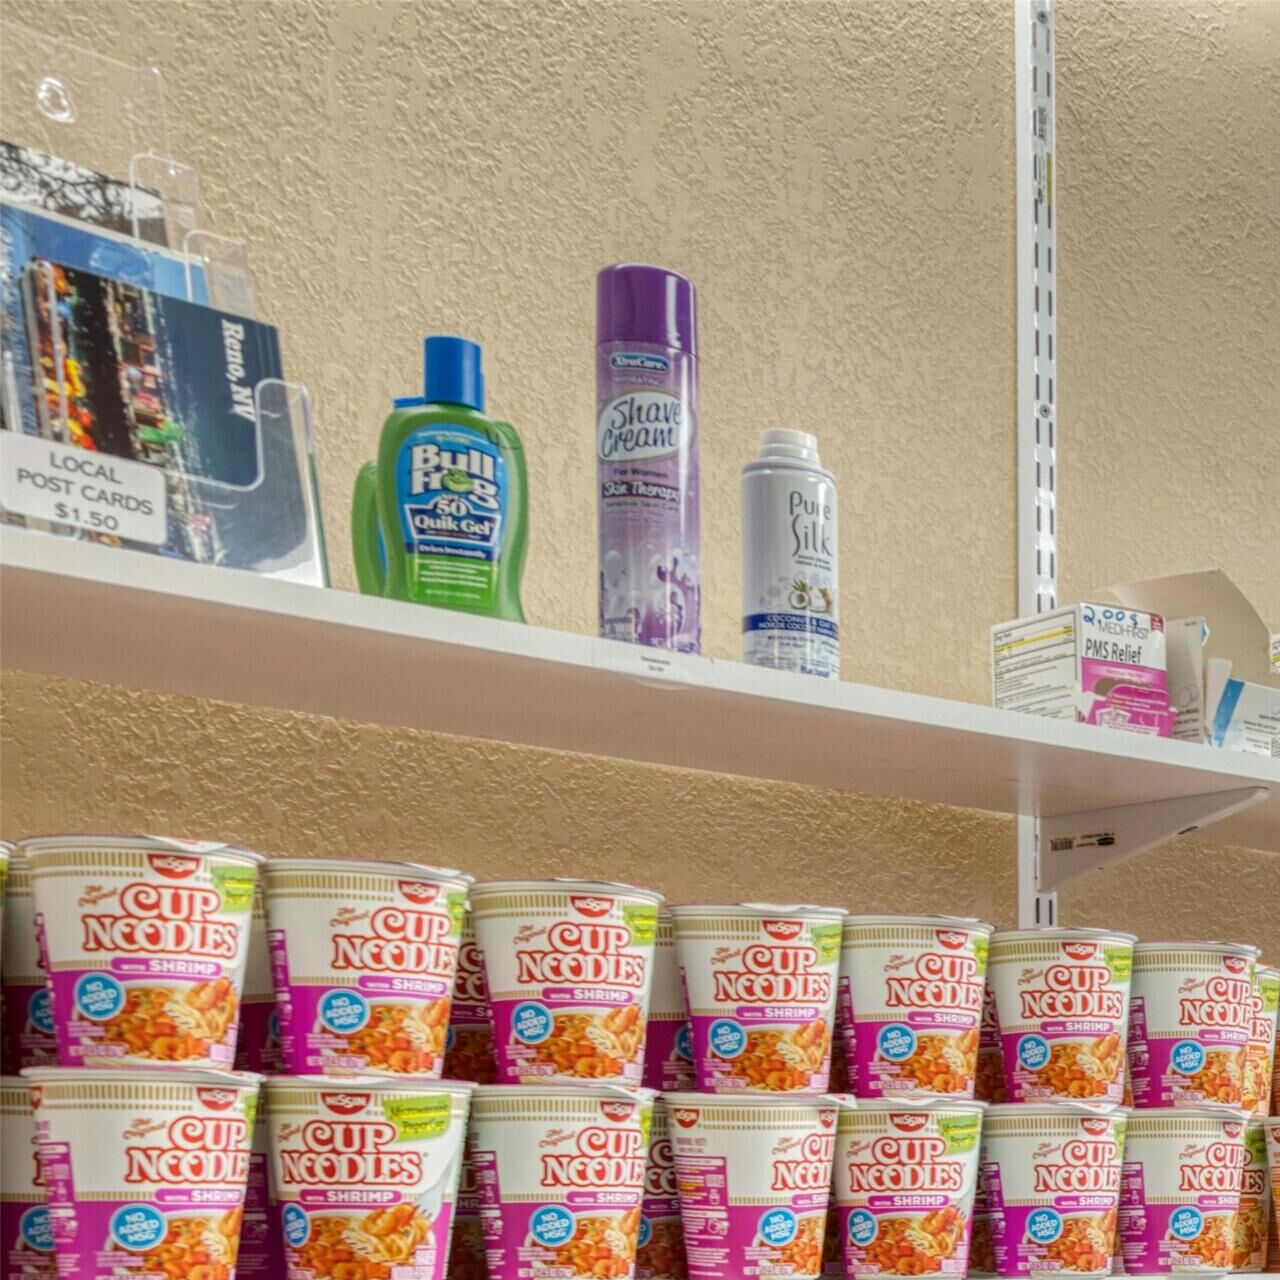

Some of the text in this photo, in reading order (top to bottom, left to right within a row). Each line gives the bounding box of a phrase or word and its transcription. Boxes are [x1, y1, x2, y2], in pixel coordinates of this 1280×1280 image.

[611, 397, 682, 430] Shave
[49, 451, 121, 484] LOCAL
[411, 444, 494, 481] Bull
[17, 468, 153, 516] POST CARDS
[789, 490, 831, 520] Pure
[54, 503, 119, 532] $1.50
[414, 514, 458, 531] Quik
[436, 500, 468, 517] 50
[792, 514, 832, 557] Silk
[1085, 638, 1142, 664] PMS Relief
[120, 883, 221, 921] CUP
[82, 915, 238, 959] NOODLES
[371, 907, 451, 943] CUP
[548, 922, 632, 955] CUP
[149, 959, 217, 975] SHRIMP
[517, 951, 645, 988] NOODLES
[743, 944, 819, 975] CUP
[916, 953, 977, 983] CUP
[714, 971, 831, 1003] NOODLES
[1045, 965, 1111, 992] CUP
[573, 989, 628, 1001] SHRIMP
[1021, 991, 1122, 1019] NOODLES
[764, 1008, 815, 1018] SHRIMP
[169, 1116, 248, 1150] CUP
[303, 1120, 396, 1152] CUP
[872, 1137, 947, 1164] CUP
[1063, 1140, 1117, 1166] CUP
[281, 1151, 422, 1185] NOODLES
[849, 1163, 963, 1191] NOODLES
[327, 1191, 394, 1202] SHRIMP
[893, 1196, 944, 1206] SHRIMP
